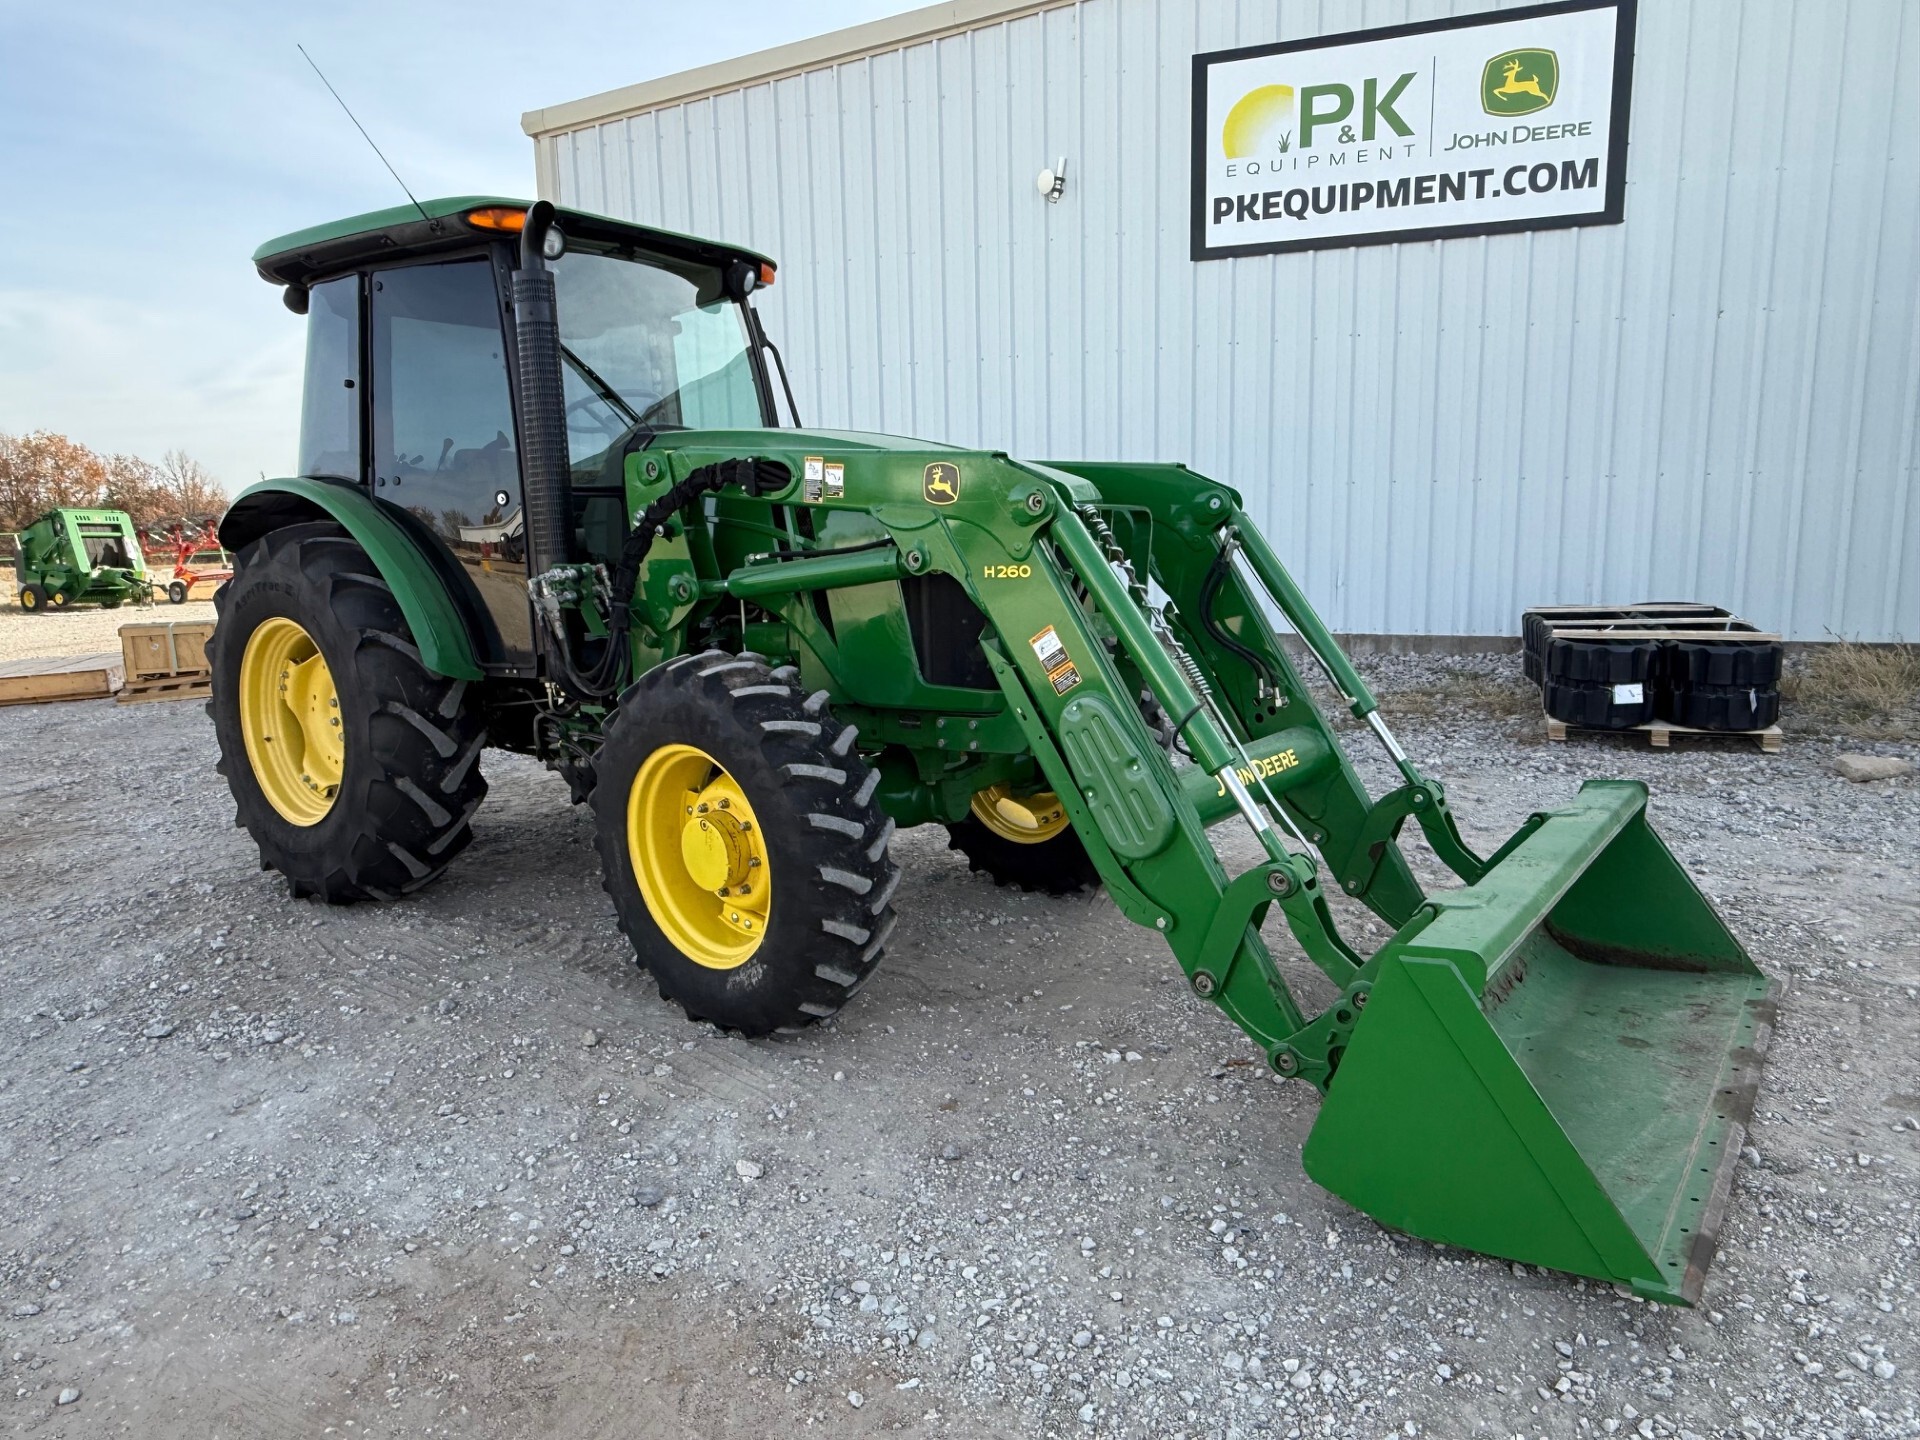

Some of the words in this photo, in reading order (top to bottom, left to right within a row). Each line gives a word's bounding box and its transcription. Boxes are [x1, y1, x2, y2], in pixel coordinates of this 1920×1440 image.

[1300, 72, 1418, 149] P&K
[1444, 130, 1508, 151] JOHN
[1512, 121, 1592, 144] DEERE
[1226, 143, 1416, 177] EQUIPMENT
[1213, 157, 1599, 225] PKEQUIPMENT.COM
[984, 565, 1031, 578] H260
[1214, 766, 1255, 797] JHN
[1250, 748, 1299, 780] DEERE
